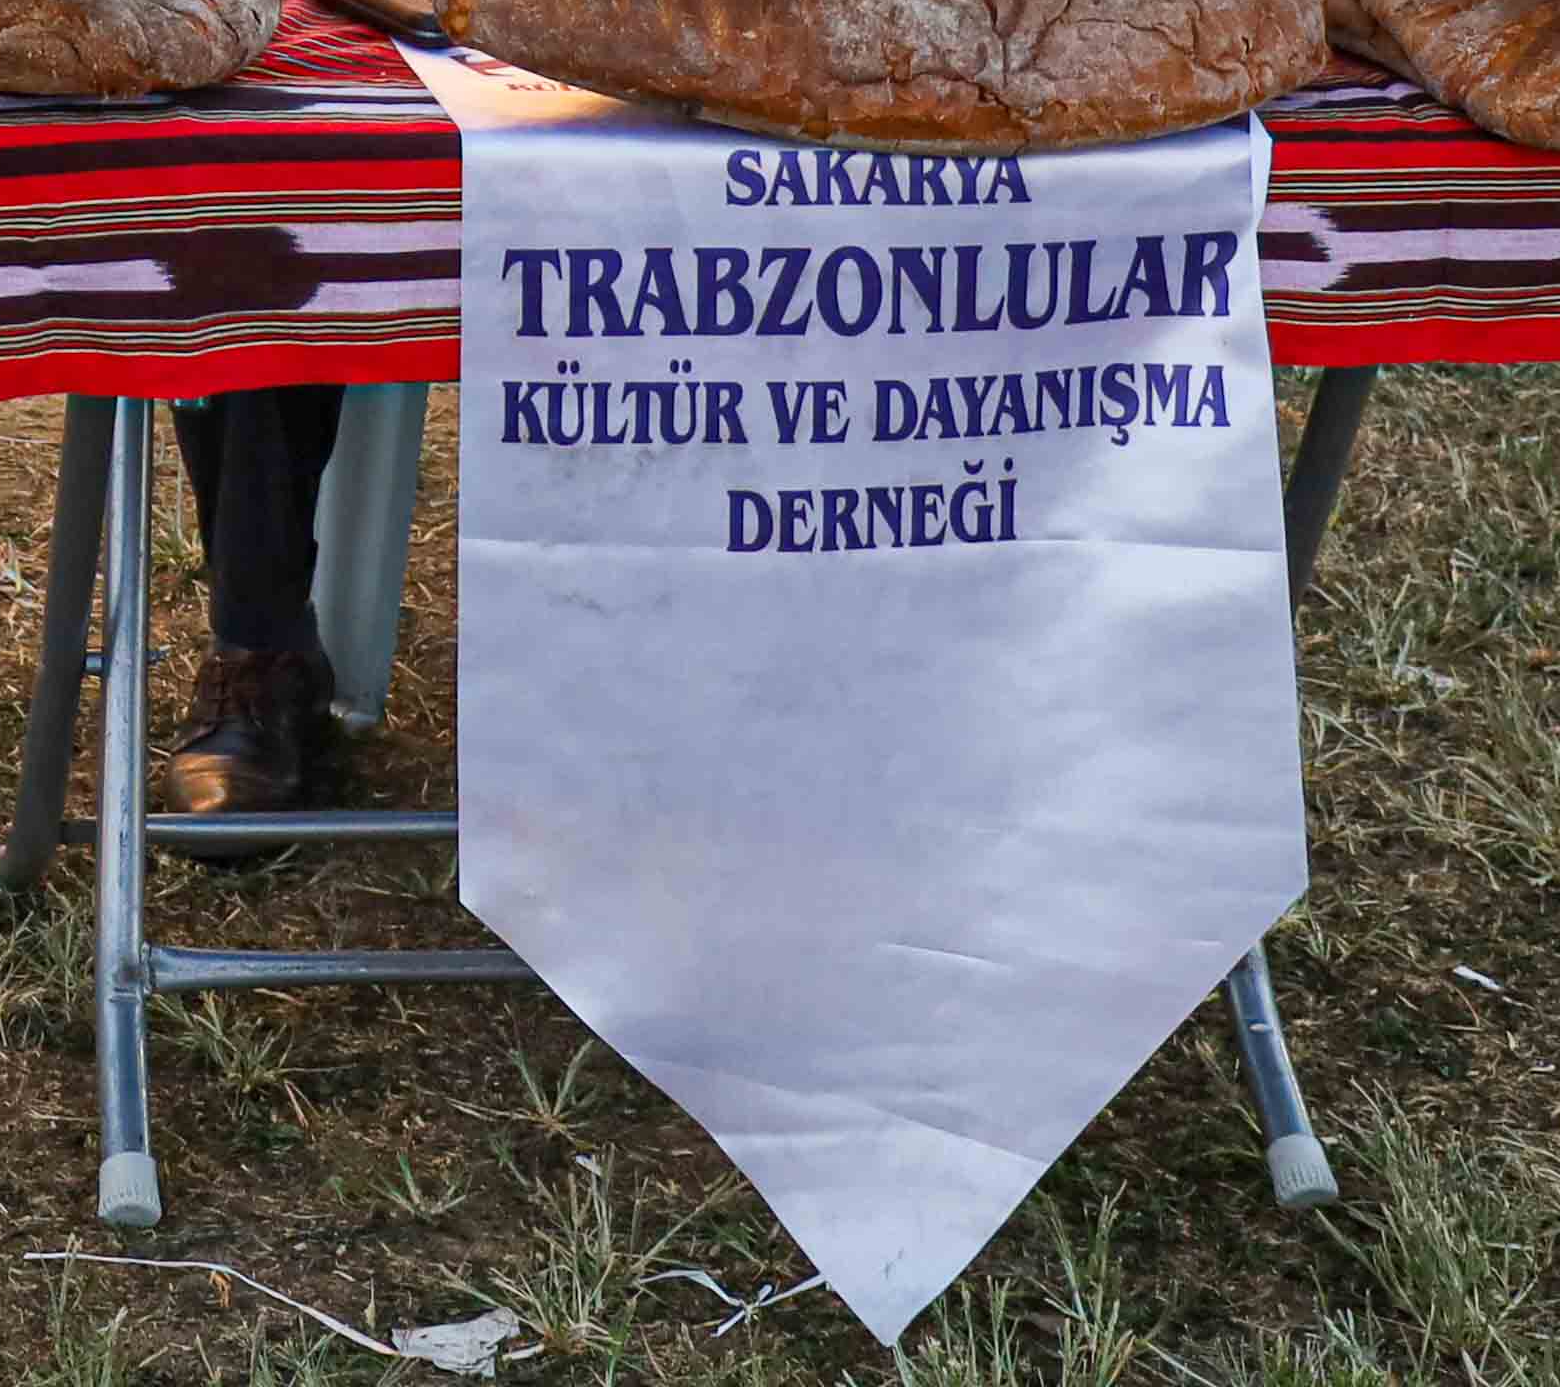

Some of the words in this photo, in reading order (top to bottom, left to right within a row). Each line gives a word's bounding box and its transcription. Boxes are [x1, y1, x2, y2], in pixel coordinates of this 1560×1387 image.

[725, 149, 1032, 207] SAKARYA
[500, 230, 1239, 339] TRABZONLULAR
[500, 360, 747, 447] KÜLTÜR
[766, 379, 851, 445] VE
[871, 362, 1231, 446] DAYANIŞMA
[726, 457, 1019, 554] DERNEĞİ
